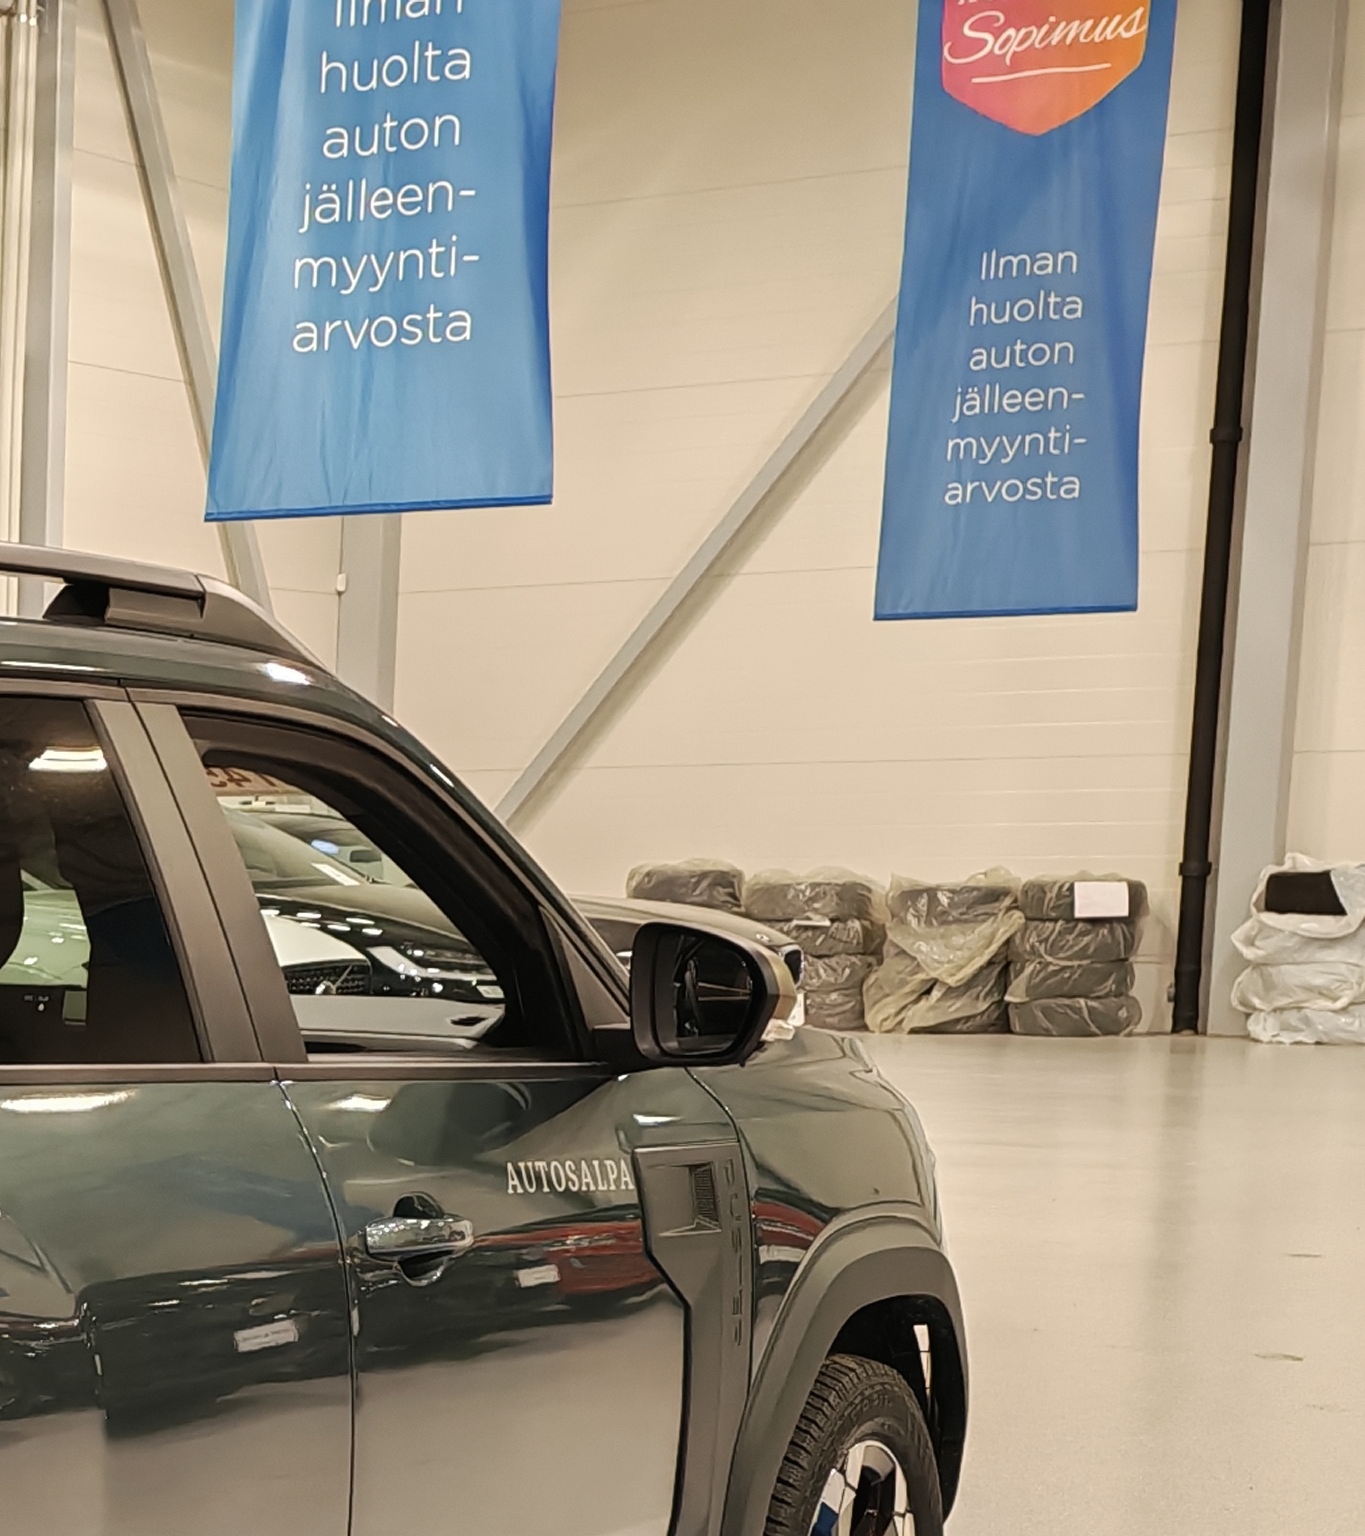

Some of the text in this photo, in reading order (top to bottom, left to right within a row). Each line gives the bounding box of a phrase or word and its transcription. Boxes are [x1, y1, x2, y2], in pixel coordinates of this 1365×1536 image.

[944, 6, 1147, 65] Sopimus
[320, 40, 471, 94] huolta
[322, 112, 461, 159] auton
[298, 177, 477, 234] jälleen-
[294, 234, 481, 295] myynti-
[980, 248, 1078, 281] Ilman
[292, 303, 473, 353] arvosta
[969, 289, 1083, 327] huolta
[969, 339, 1075, 371] auton
[951, 381, 1086, 424] jälleen-
[945, 424, 1087, 465] myynti-
[944, 470, 1081, 506] arvosta
[507, 1159, 634, 1194] AUTOSALPA
